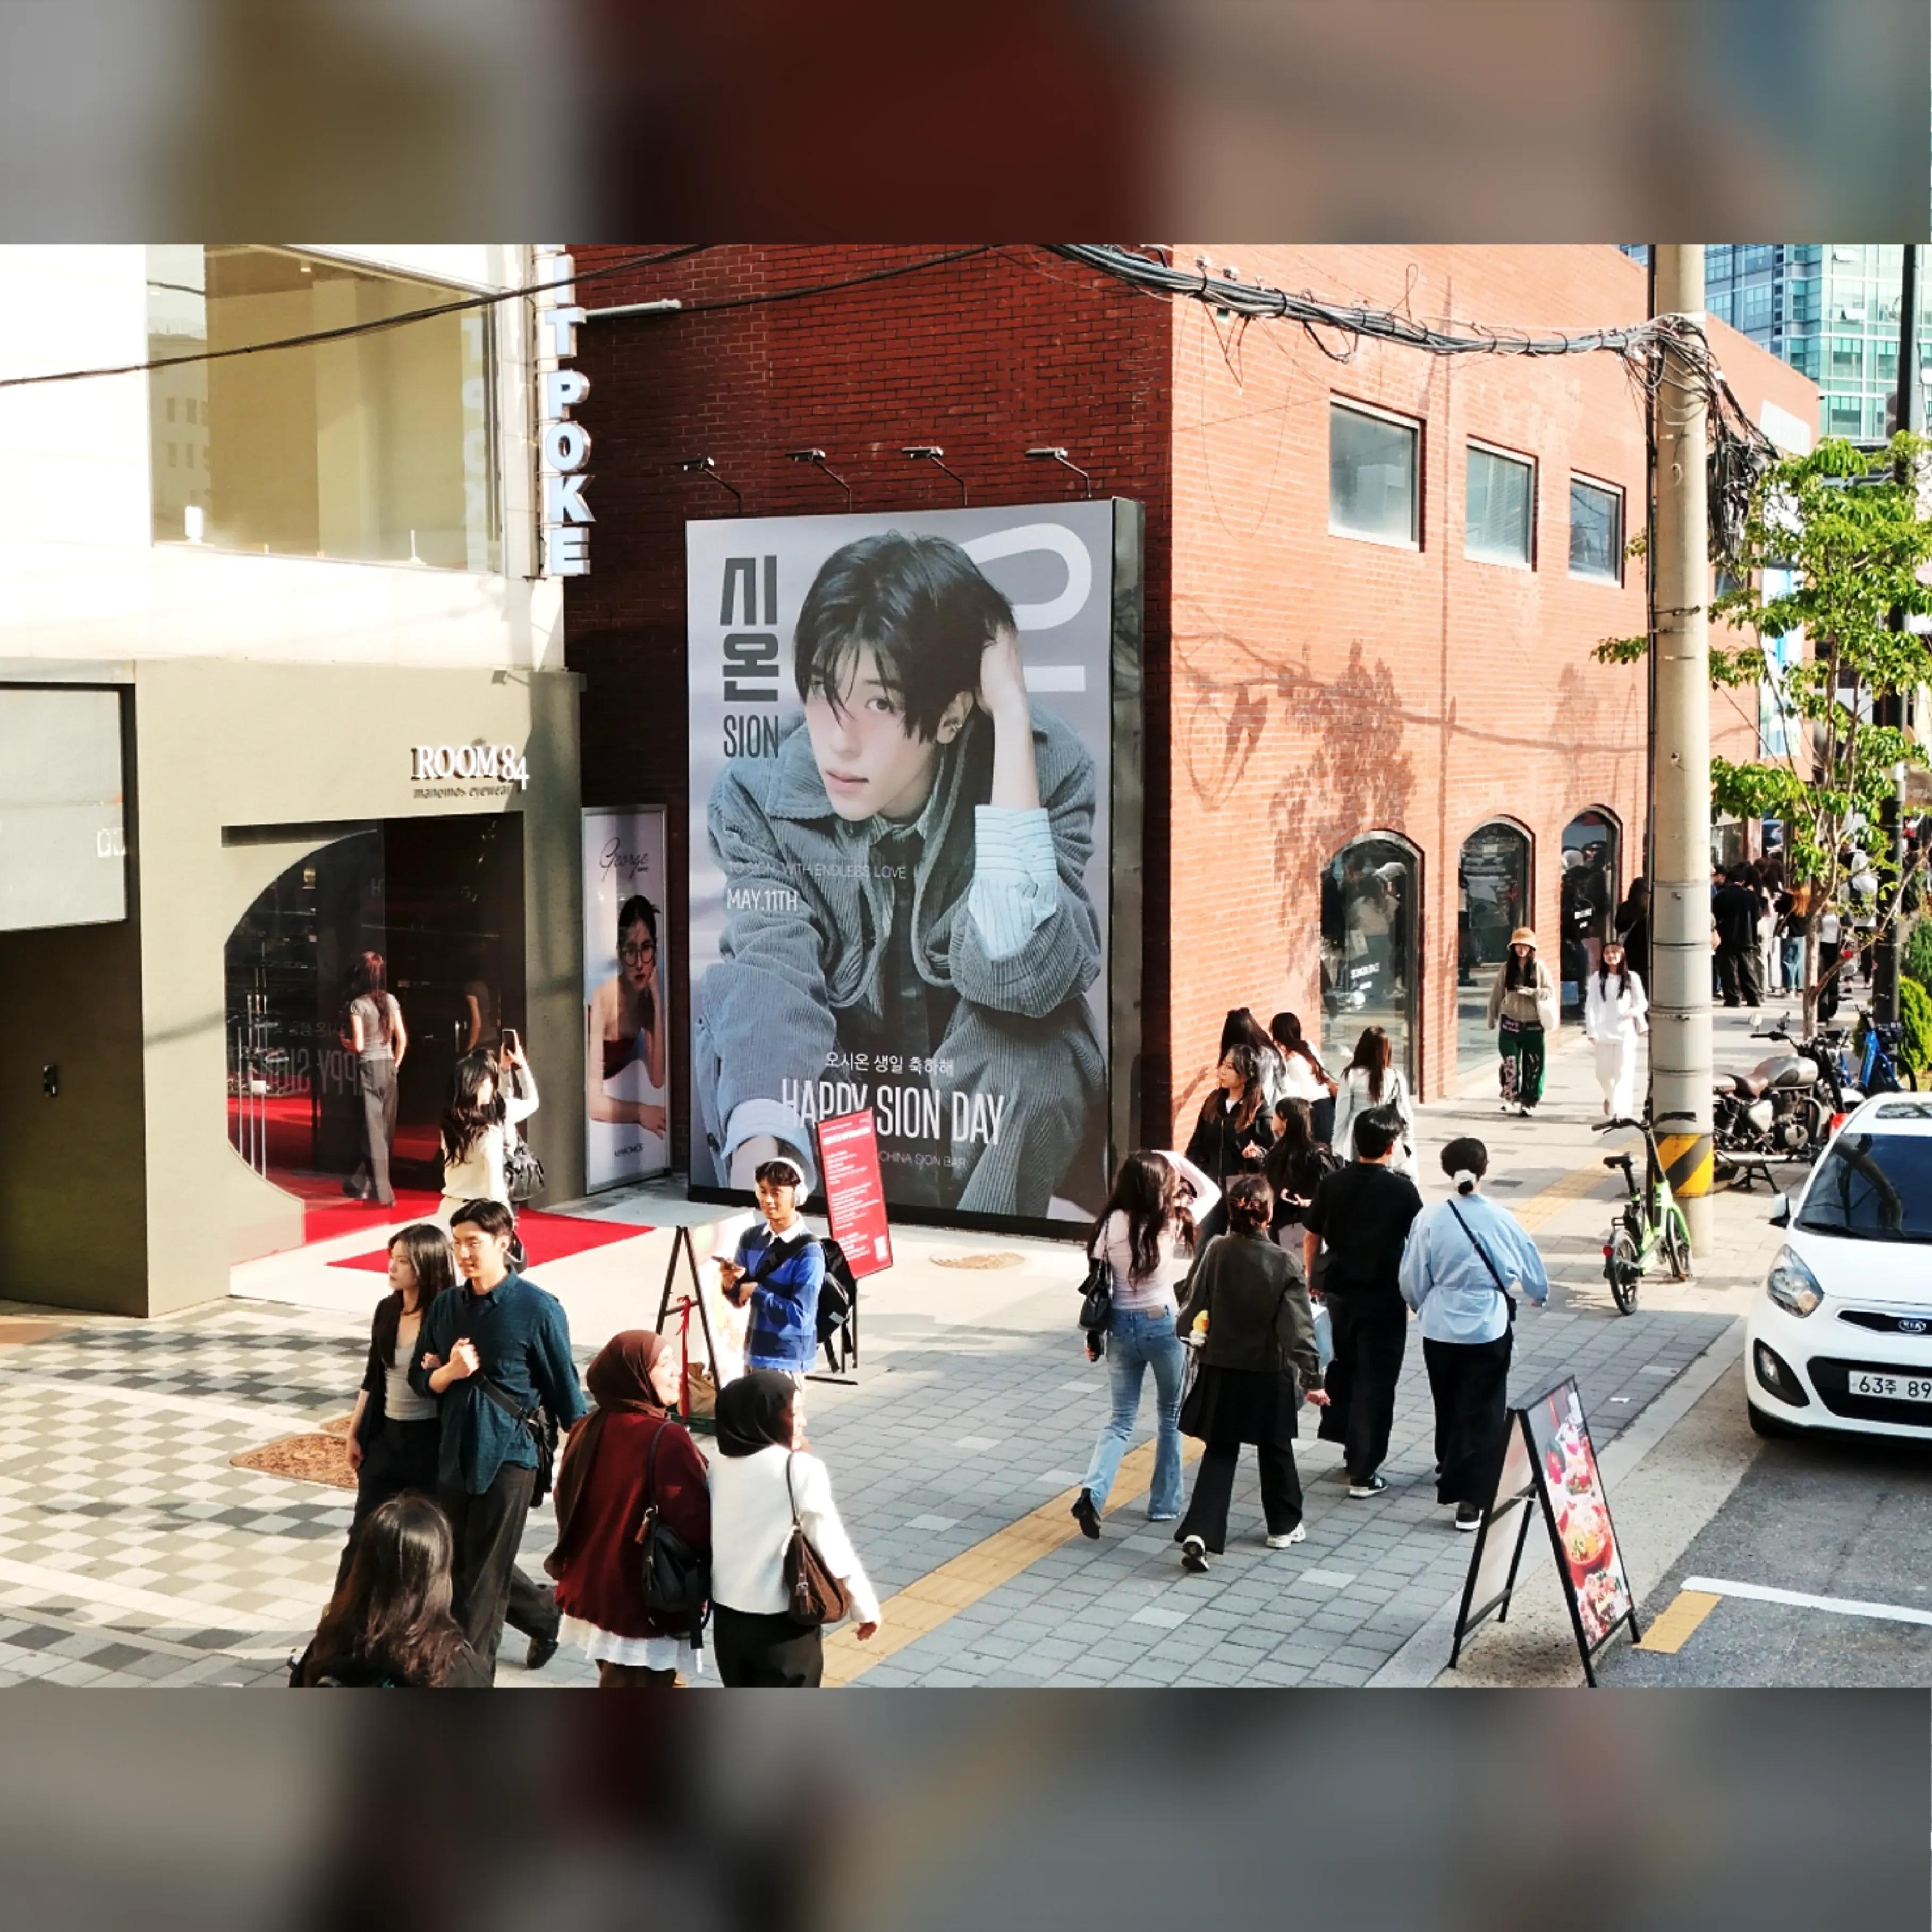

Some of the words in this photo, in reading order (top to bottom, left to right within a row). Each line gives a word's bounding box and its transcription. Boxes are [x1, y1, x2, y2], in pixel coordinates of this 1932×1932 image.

[543, 244, 586, 357] IT
[720, 555, 779, 702] 시온
[724, 715, 778, 758] SION
[874, 865, 906, 879] LOVE
[726, 888, 797, 911] MAY.11TH
[825, 1052, 870, 1072] 오시온
[874, 1054, 903, 1074] 생일
[908, 1056, 954, 1077] 축하해
[877, 1085, 940, 1140] SION
[952, 1092, 1004, 1145] DAY
